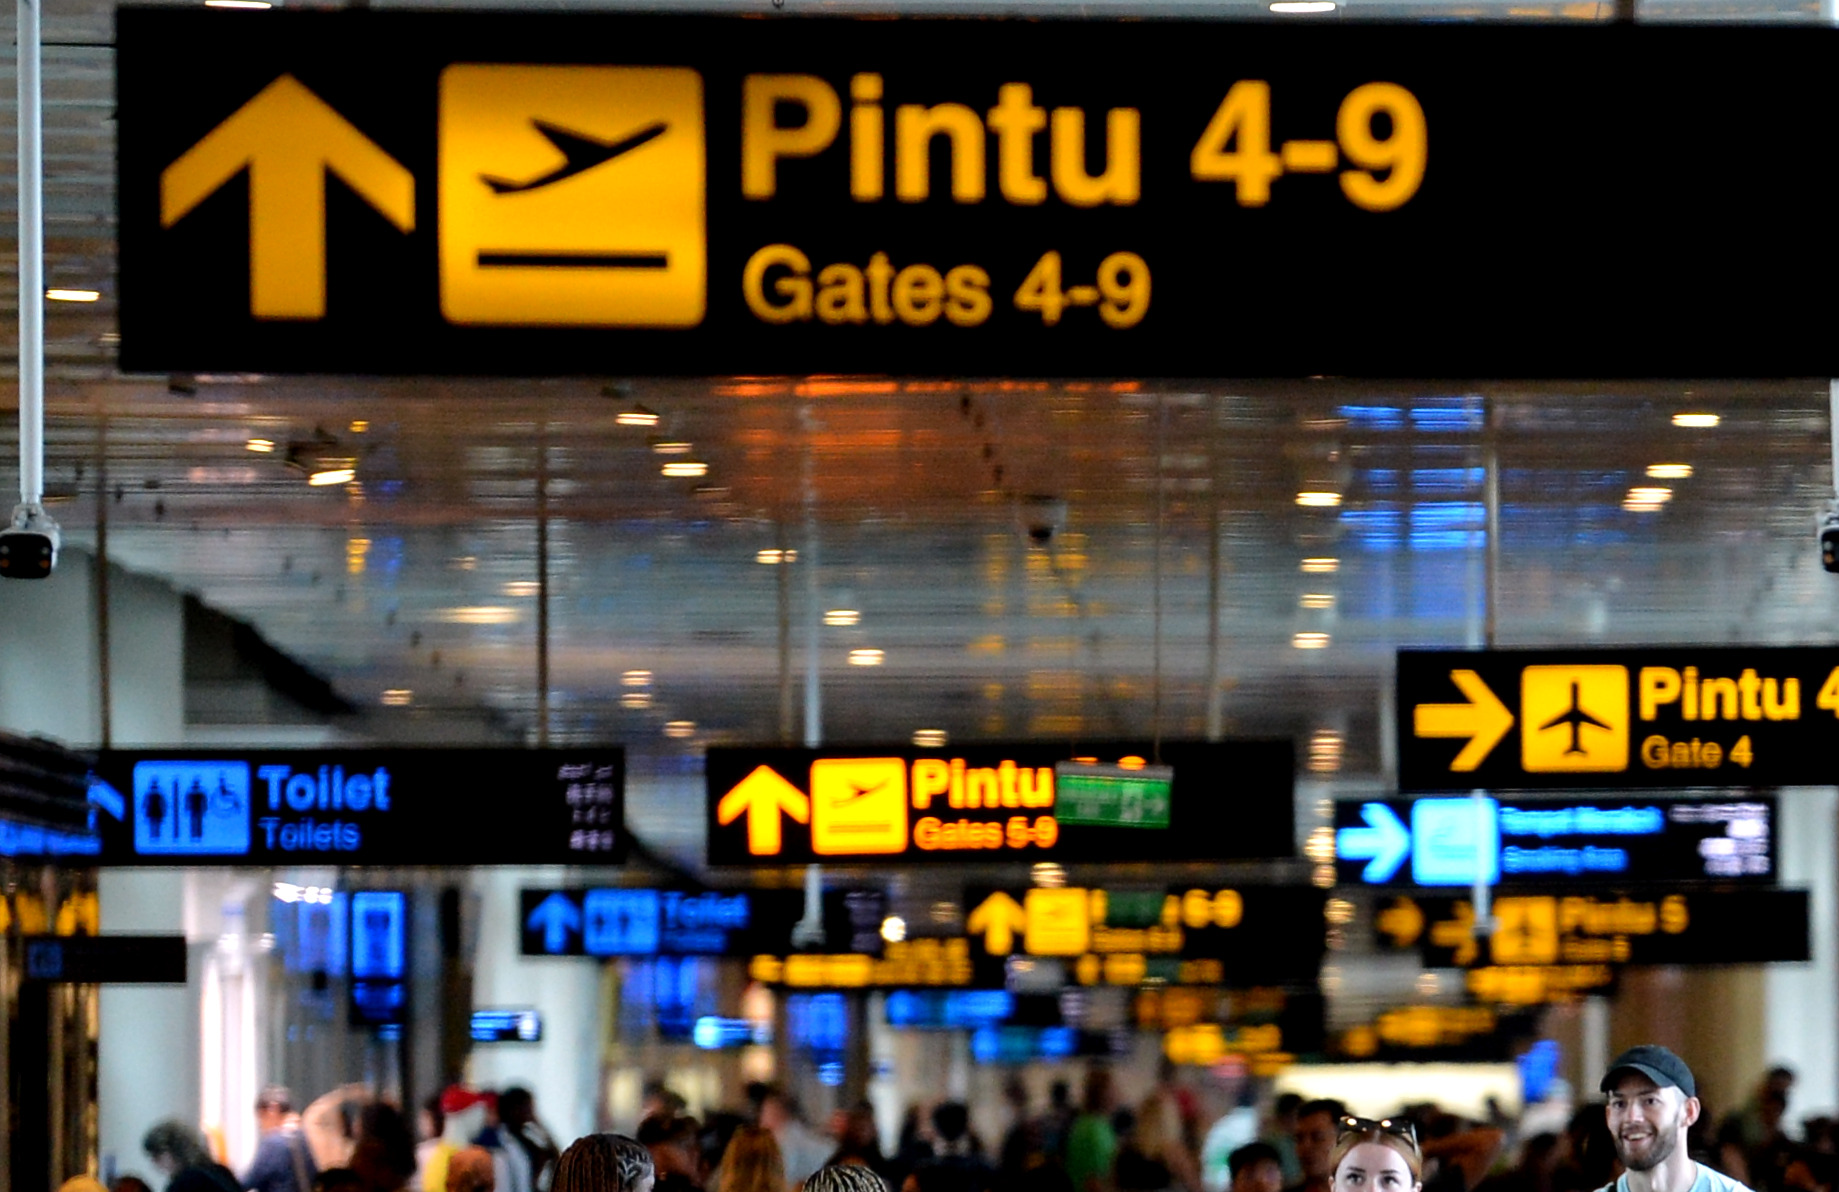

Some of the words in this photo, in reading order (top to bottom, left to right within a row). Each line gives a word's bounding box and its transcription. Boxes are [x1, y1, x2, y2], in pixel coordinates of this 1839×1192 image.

[741, 72, 1142, 207] Pintu
[1189, 79, 1429, 212] 4-9
[742, 243, 993, 327] Gates
[1013, 250, 1153, 328] 4-9
[1638, 664, 1802, 722] Pintu
[1640, 733, 1724, 768] Gate
[1728, 734, 1754, 768] 4
[257, 763, 391, 813] Toilet
[911, 758, 1055, 809] Pintu
[258, 815, 361, 852] Toilets
[913, 816, 1004, 850] Gates
